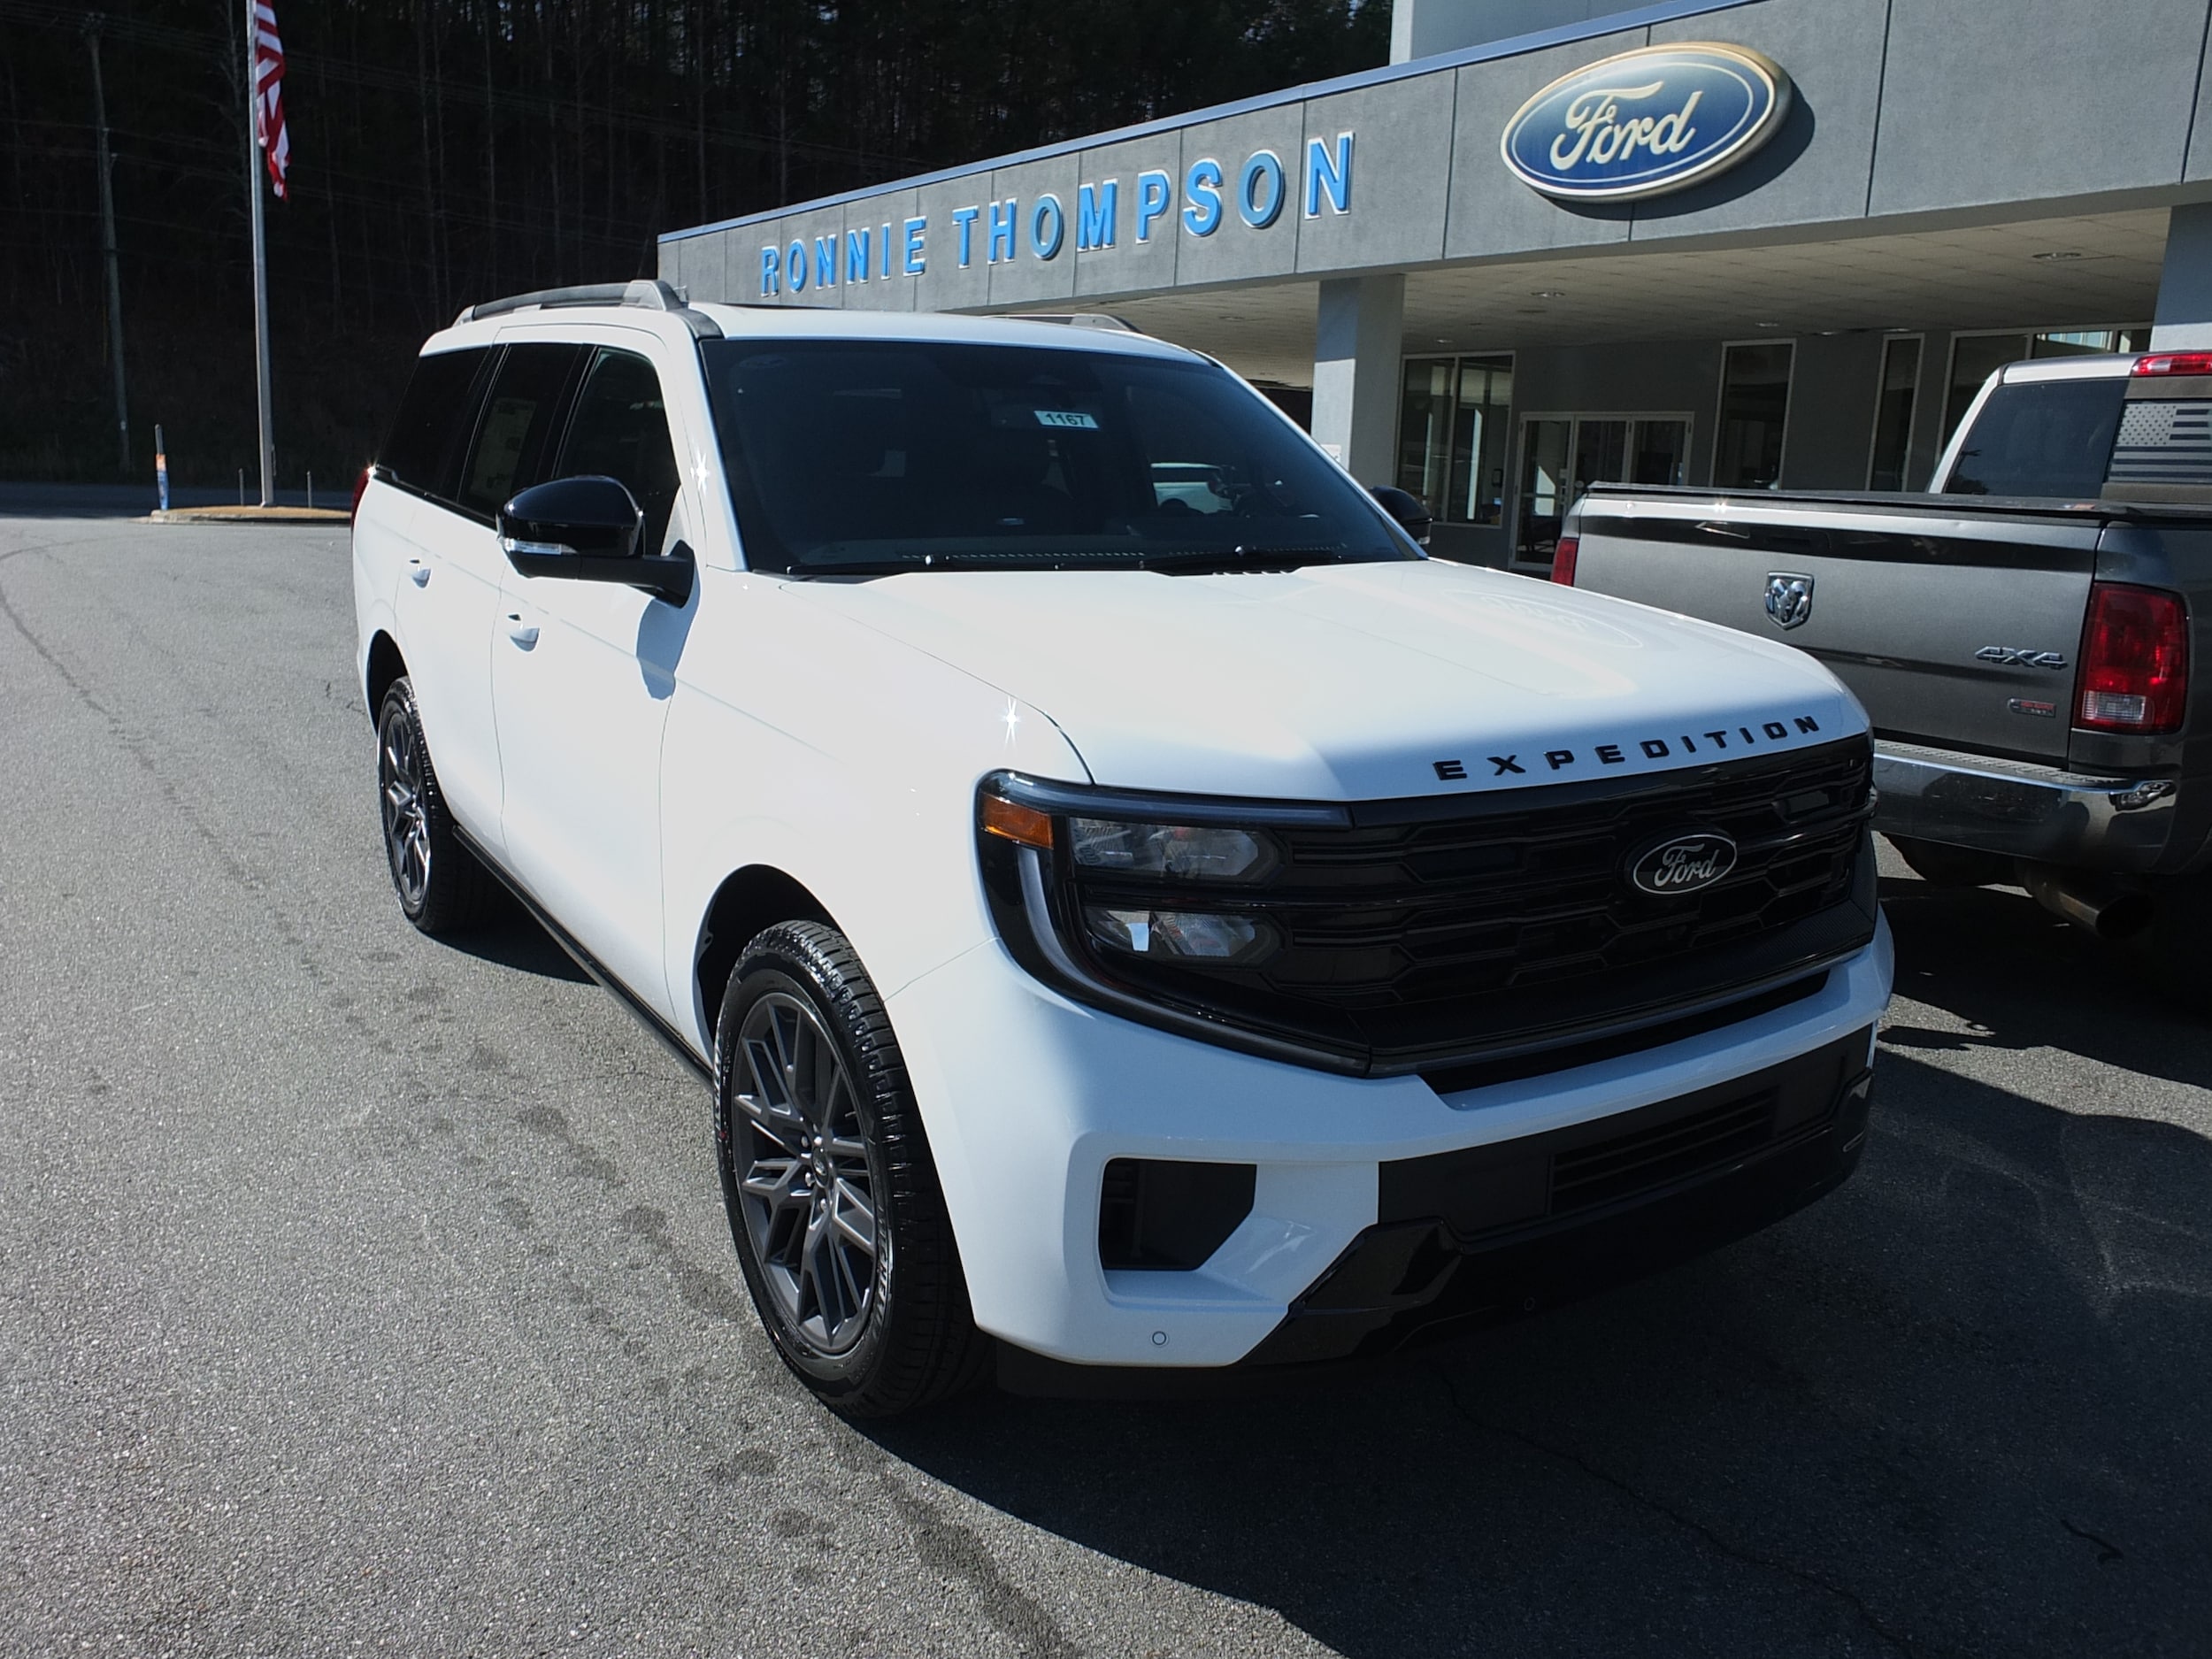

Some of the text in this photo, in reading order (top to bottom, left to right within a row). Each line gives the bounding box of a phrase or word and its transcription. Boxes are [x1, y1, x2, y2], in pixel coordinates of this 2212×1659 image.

[1549, 81, 1703, 171] Ford
[761, 131, 1354, 297] RONNIE THOMPSON
[1046, 412, 1085, 426] 1167
[1432, 715, 1821, 780] EXPEDITION
[1654, 844, 1719, 887] Ford
